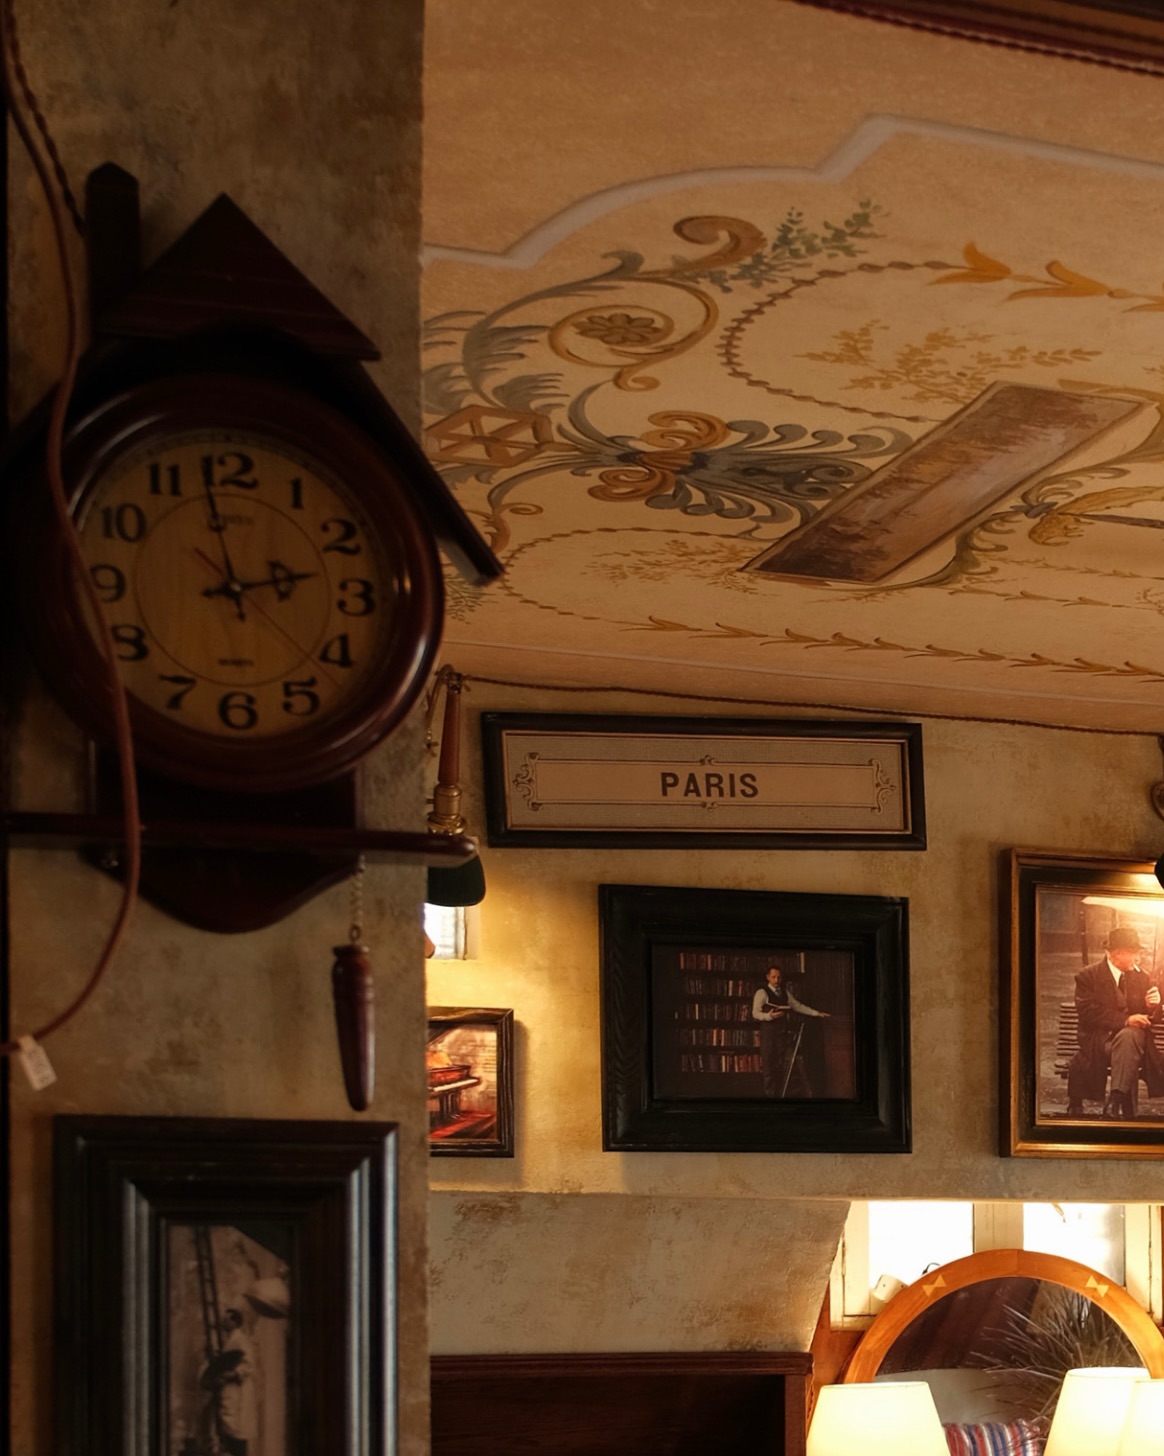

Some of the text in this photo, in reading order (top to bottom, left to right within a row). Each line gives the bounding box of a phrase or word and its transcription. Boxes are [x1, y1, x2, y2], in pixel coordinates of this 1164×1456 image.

[148, 462, 182, 496] 11
[201, 451, 259, 490] 12
[290, 477, 303, 510] 1
[101, 502, 146, 543] 10
[320, 518, 361, 555] 2
[90, 564, 126, 602] 9
[338, 578, 376, 617] 3
[112, 624, 148, 662] 8
[319, 634, 354, 668] 4
[159, 674, 197, 710] 7
[218, 691, 258, 730] 6
[282, 677, 320, 716] 5
[660, 772, 759, 798] PARIS
